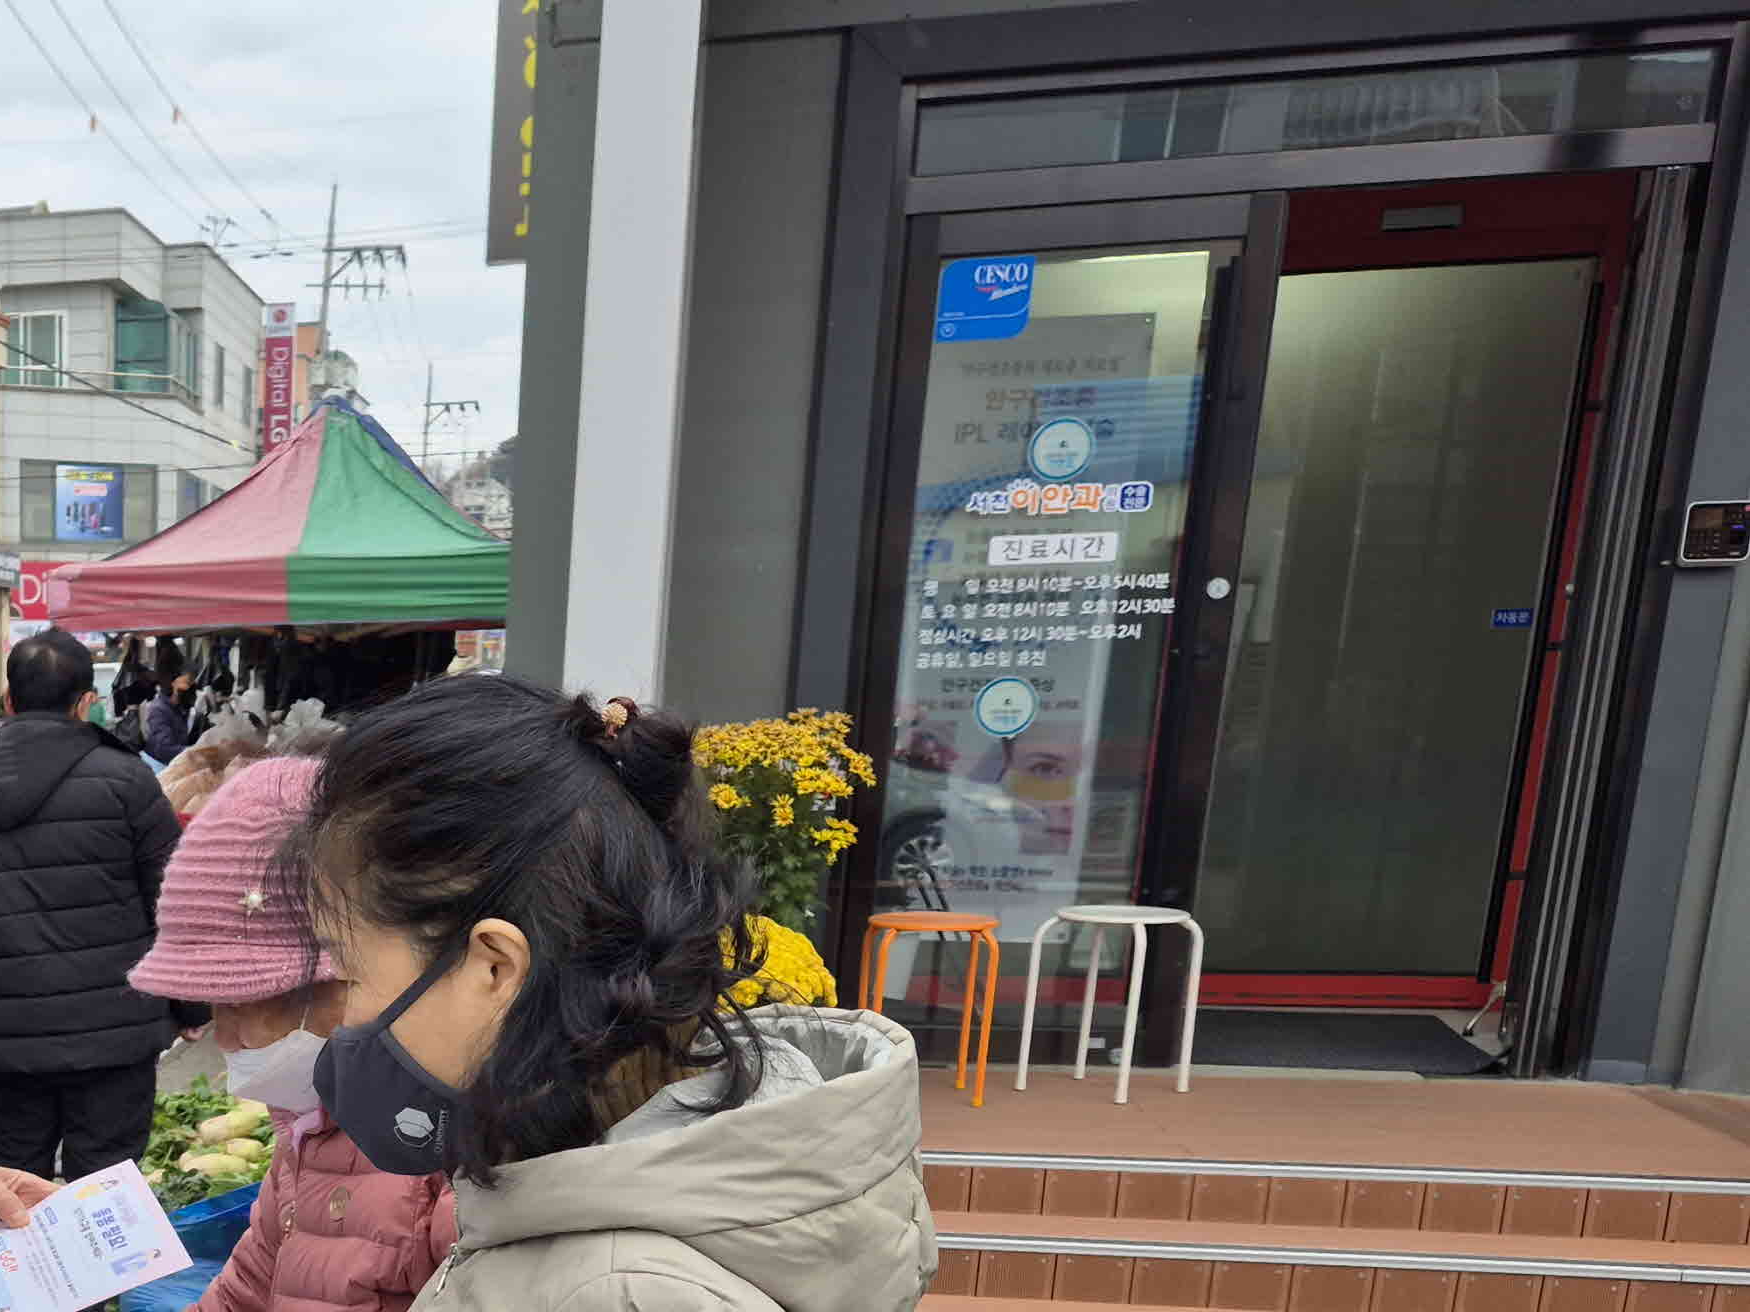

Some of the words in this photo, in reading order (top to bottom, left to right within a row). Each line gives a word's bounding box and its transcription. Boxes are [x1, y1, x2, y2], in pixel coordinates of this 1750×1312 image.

[974, 262, 1028, 284] CESCO
[266, 347, 290, 408] Digital
[270, 414, 288, 444] LG
[1002, 535, 1105, 561] 진료시간
[917, 628, 977, 645] 점심시간
[968, 651, 1011, 668] 일요일
